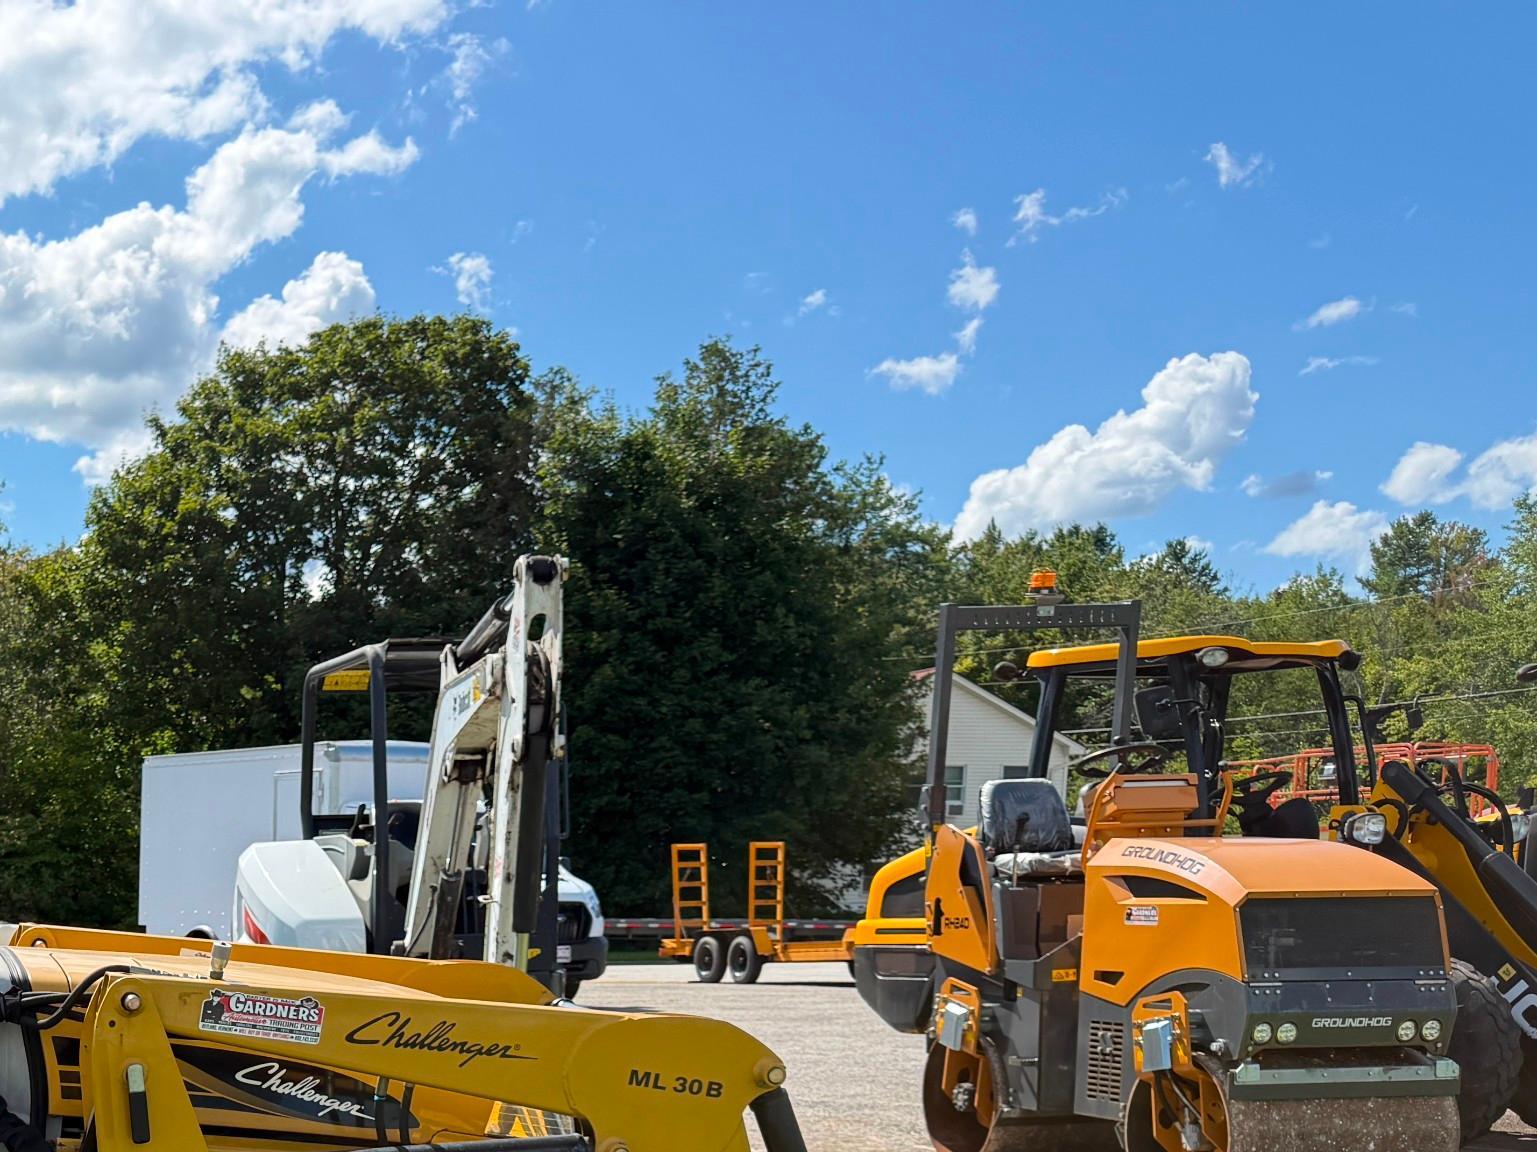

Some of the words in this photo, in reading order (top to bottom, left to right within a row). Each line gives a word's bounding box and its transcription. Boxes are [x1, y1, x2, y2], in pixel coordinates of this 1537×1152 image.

[1121, 845, 1206, 875] GROUNDHOG
[229, 993, 320, 1022] GARDNERS
[269, 1019, 299, 1029] TRADING
[299, 1022, 318, 1032] POST
[1312, 1017, 1393, 1028] GROUNDHOG
[345, 1012, 538, 1067] Challenger
[235, 1062, 376, 1120] Challenger
